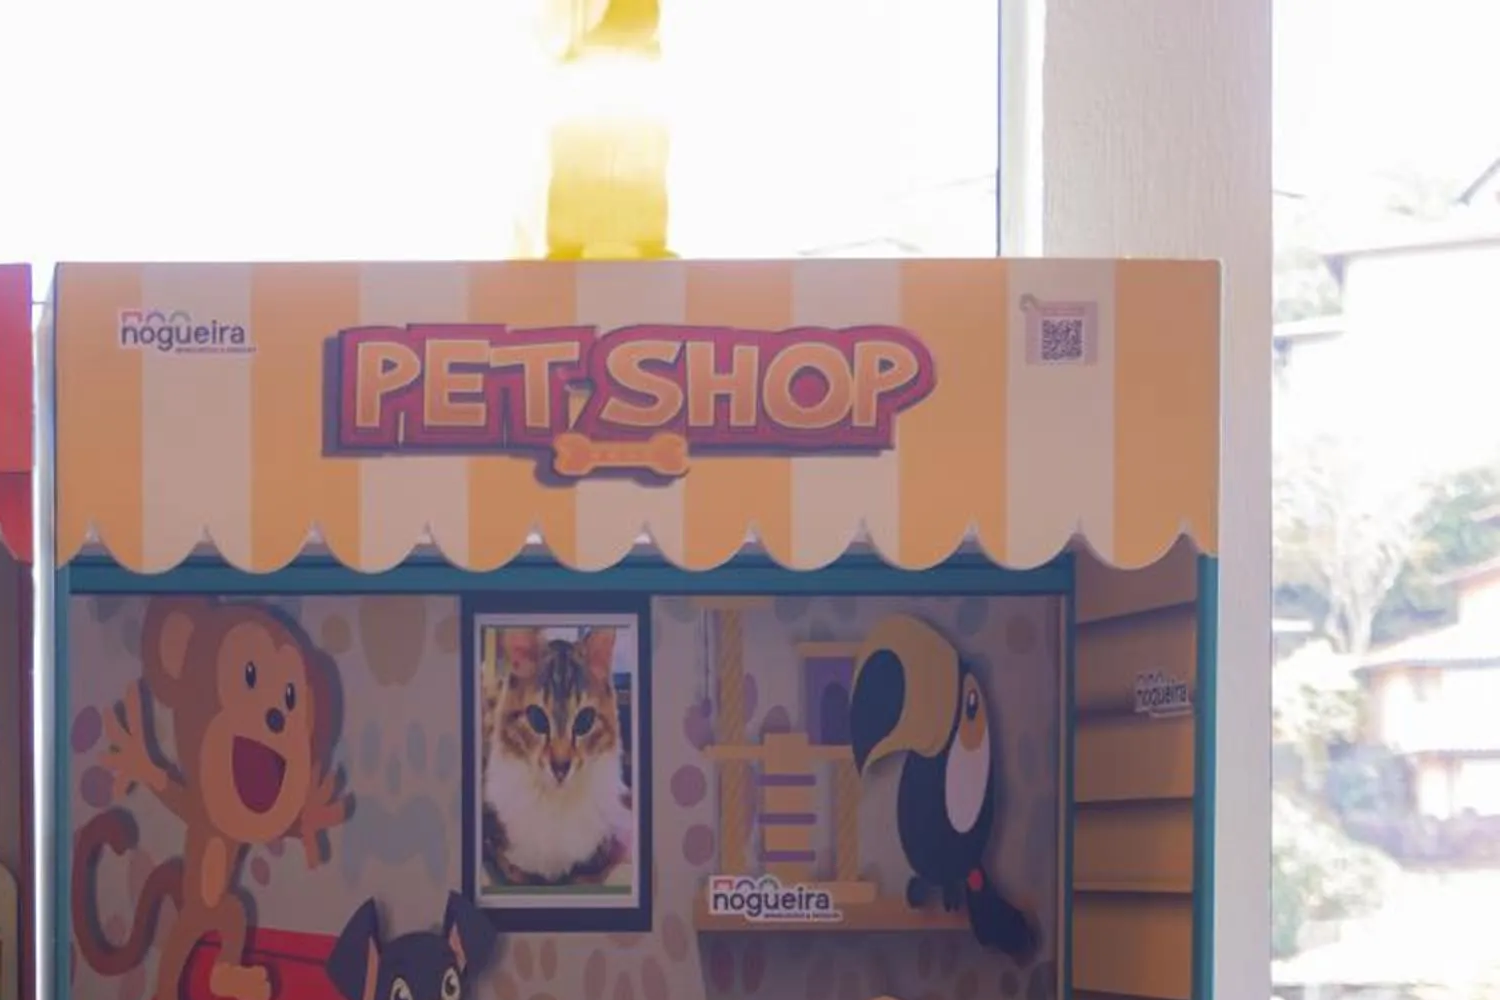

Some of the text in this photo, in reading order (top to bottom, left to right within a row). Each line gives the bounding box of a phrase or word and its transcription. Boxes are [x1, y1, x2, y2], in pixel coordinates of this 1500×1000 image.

[121, 319, 245, 352] nogueira
[355, 338, 920, 430] PET SHOP
[712, 885, 830, 917] nogueira
